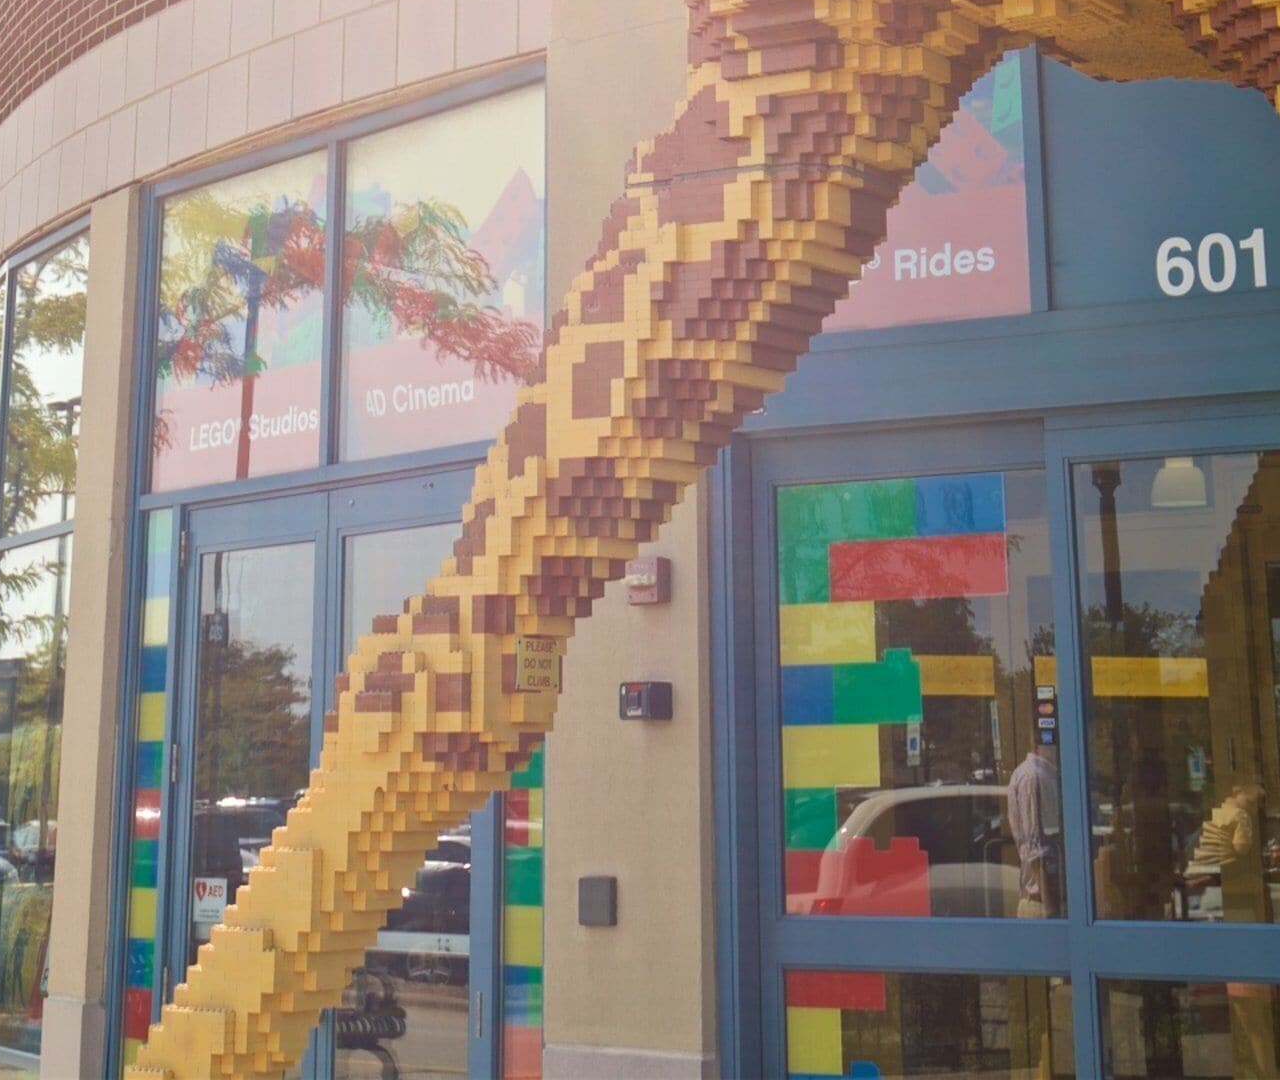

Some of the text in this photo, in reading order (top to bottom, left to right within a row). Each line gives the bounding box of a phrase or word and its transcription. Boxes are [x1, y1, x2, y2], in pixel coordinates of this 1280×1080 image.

[894, 242, 996, 281] Rides
[1156, 228, 1267, 297] 601
[367, 379, 474, 417] 4D Cinema
[248, 406, 318, 440] Studios
[525, 640, 555, 653] PLEASE
[524, 658, 552, 670] DO NOT
[527, 674, 551, 687] CLIMB
